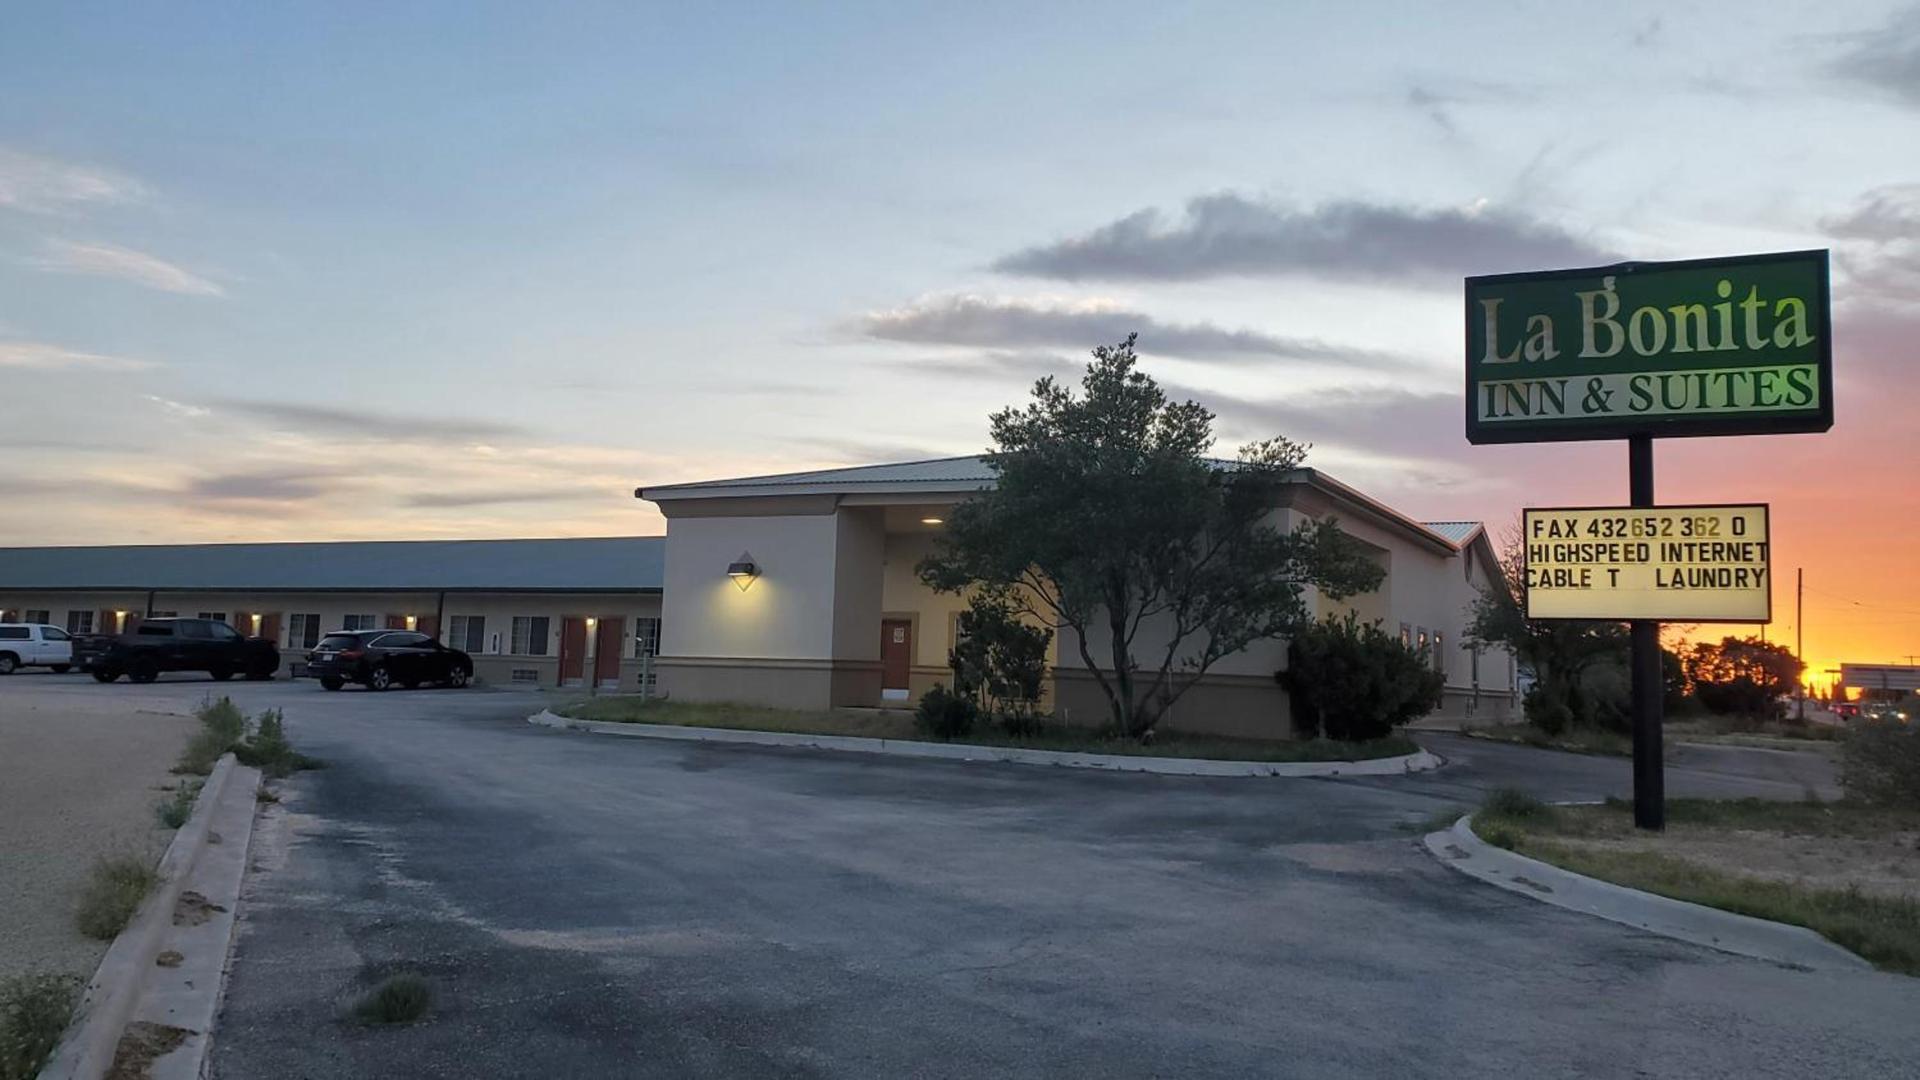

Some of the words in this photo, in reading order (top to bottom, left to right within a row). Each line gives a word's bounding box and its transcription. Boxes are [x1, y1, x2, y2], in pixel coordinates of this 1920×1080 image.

[1480, 298, 1560, 364] La
[1575, 278, 1816, 359] Bonita
[1484, 380, 1568, 418] INN
[1581, 377, 1614, 415] &
[1629, 368, 1814, 412] SUITES
[1533, 519, 1578, 539] FAX
[1530, 543, 1650, 563] HIGHSPEED
[1661, 542, 1767, 562] INTERNET
[1527, 568, 1592, 588] CABLE
[1607, 568, 1620, 588] T
[1656, 568, 1766, 588] LAUNDRY
